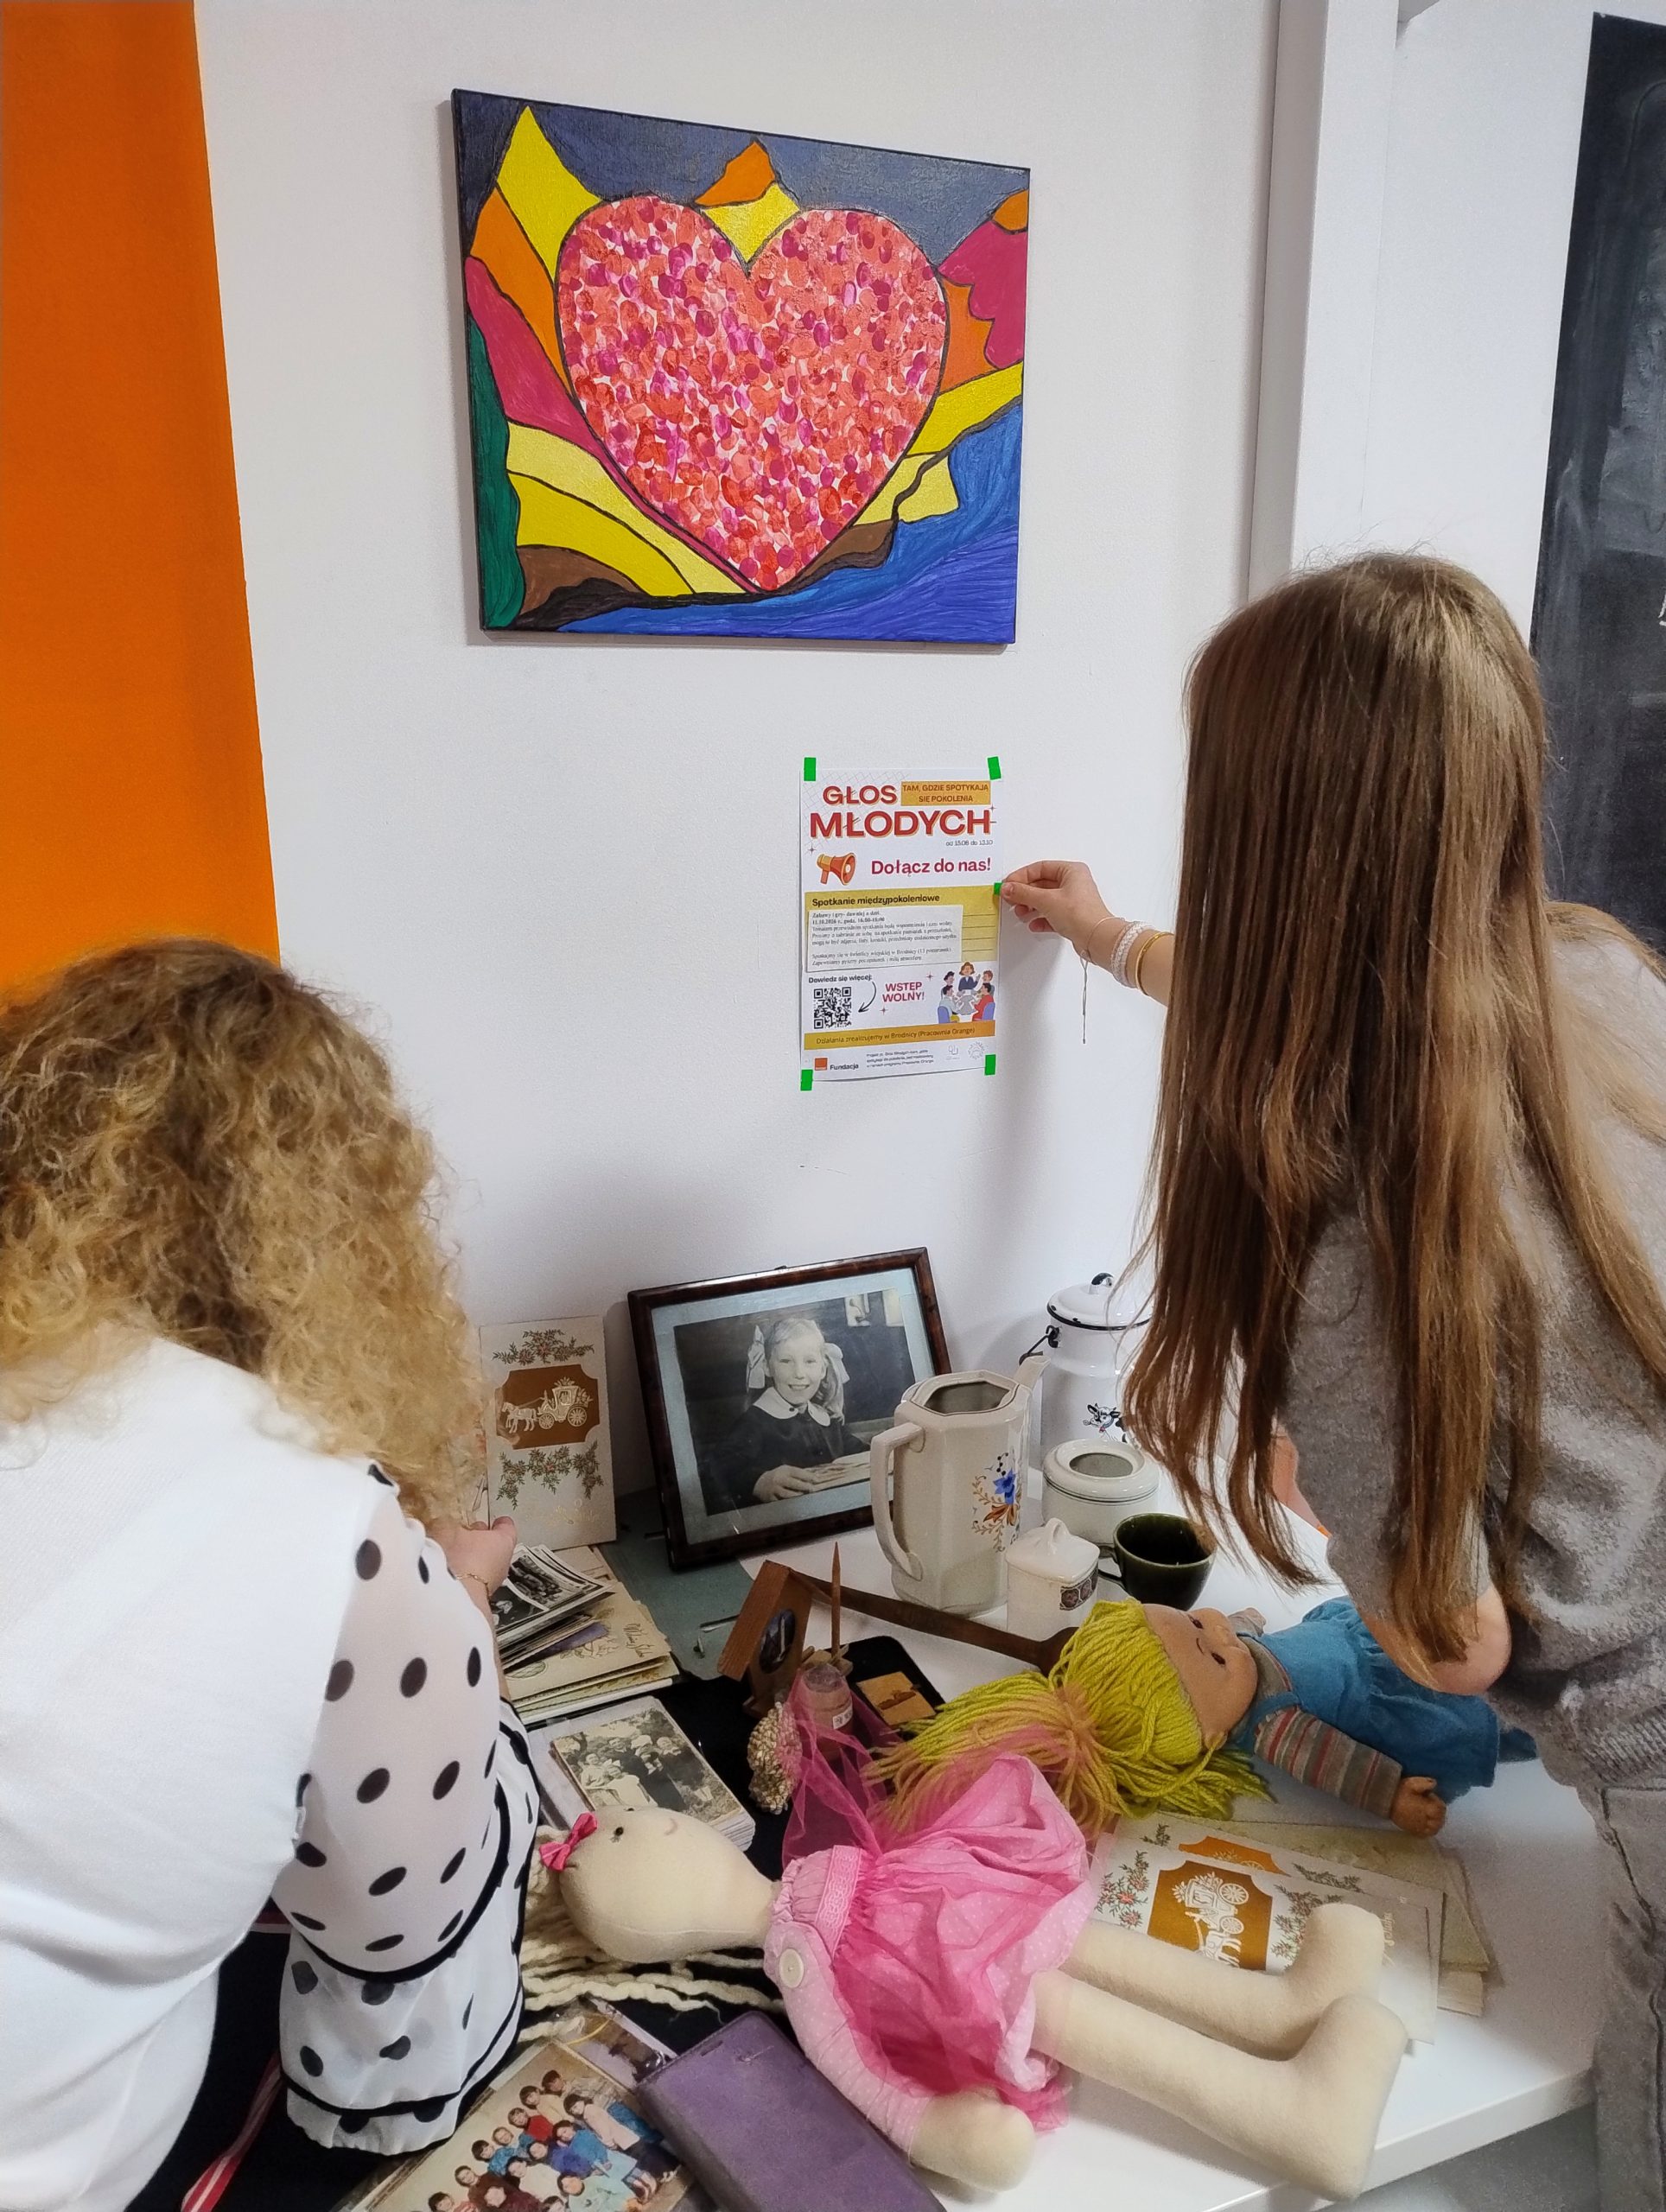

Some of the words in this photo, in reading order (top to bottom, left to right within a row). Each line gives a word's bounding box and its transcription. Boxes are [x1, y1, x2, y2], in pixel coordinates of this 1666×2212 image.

[823, 785, 897, 804] GŁOS
[811, 810, 990, 838] MŁODYCH
[872, 859, 930, 877] Dołącz
[934, 859, 955, 872] do
[958, 858, 991, 872] nas!
[812, 897, 855, 907] Spotkanie
[857, 893, 940, 905] międzypokoleniowe
[882, 992, 925, 1002] WOLNY!
